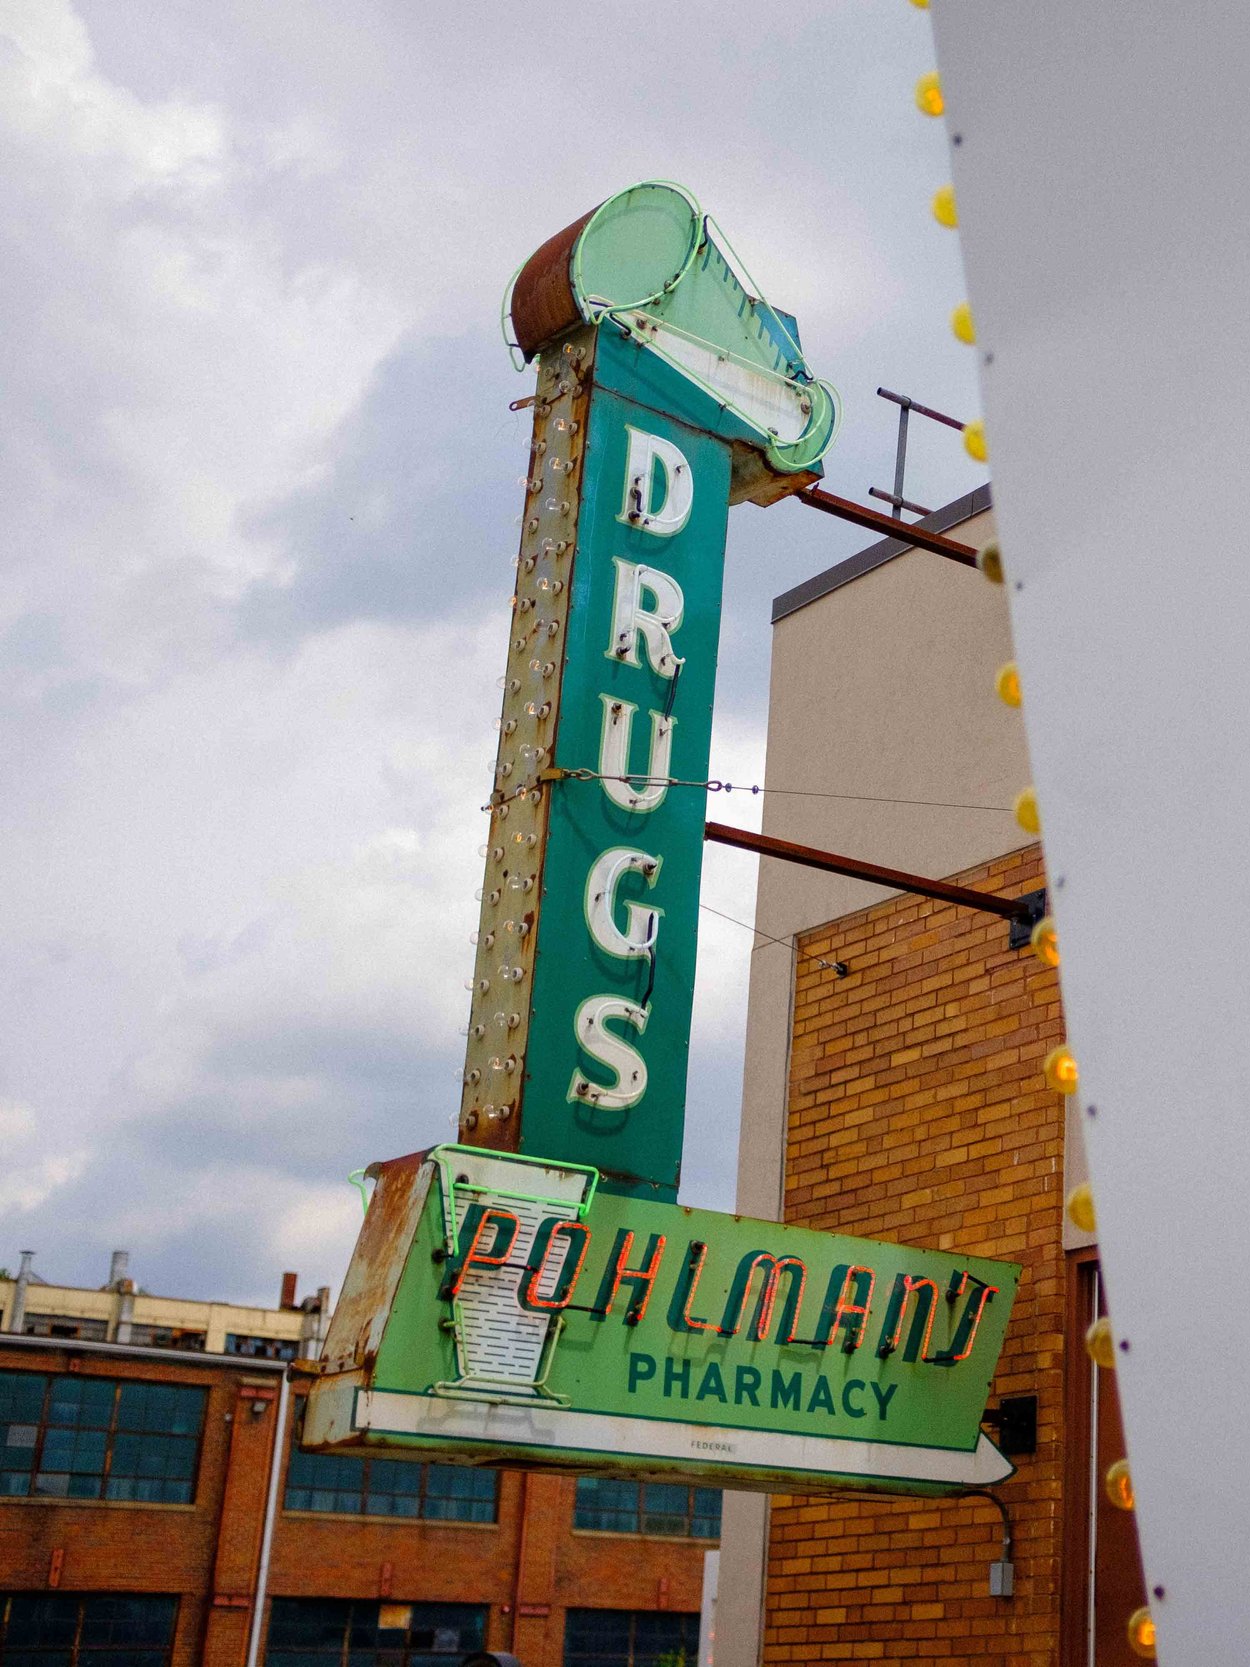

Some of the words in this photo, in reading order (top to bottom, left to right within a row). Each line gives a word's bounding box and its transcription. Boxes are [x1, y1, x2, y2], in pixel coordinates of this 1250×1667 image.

[564, 423, 695, 1112] DRUGS
[626, 1352, 899, 1422] PHARMACY
[690, 1440, 734, 1453] FEDERAL
